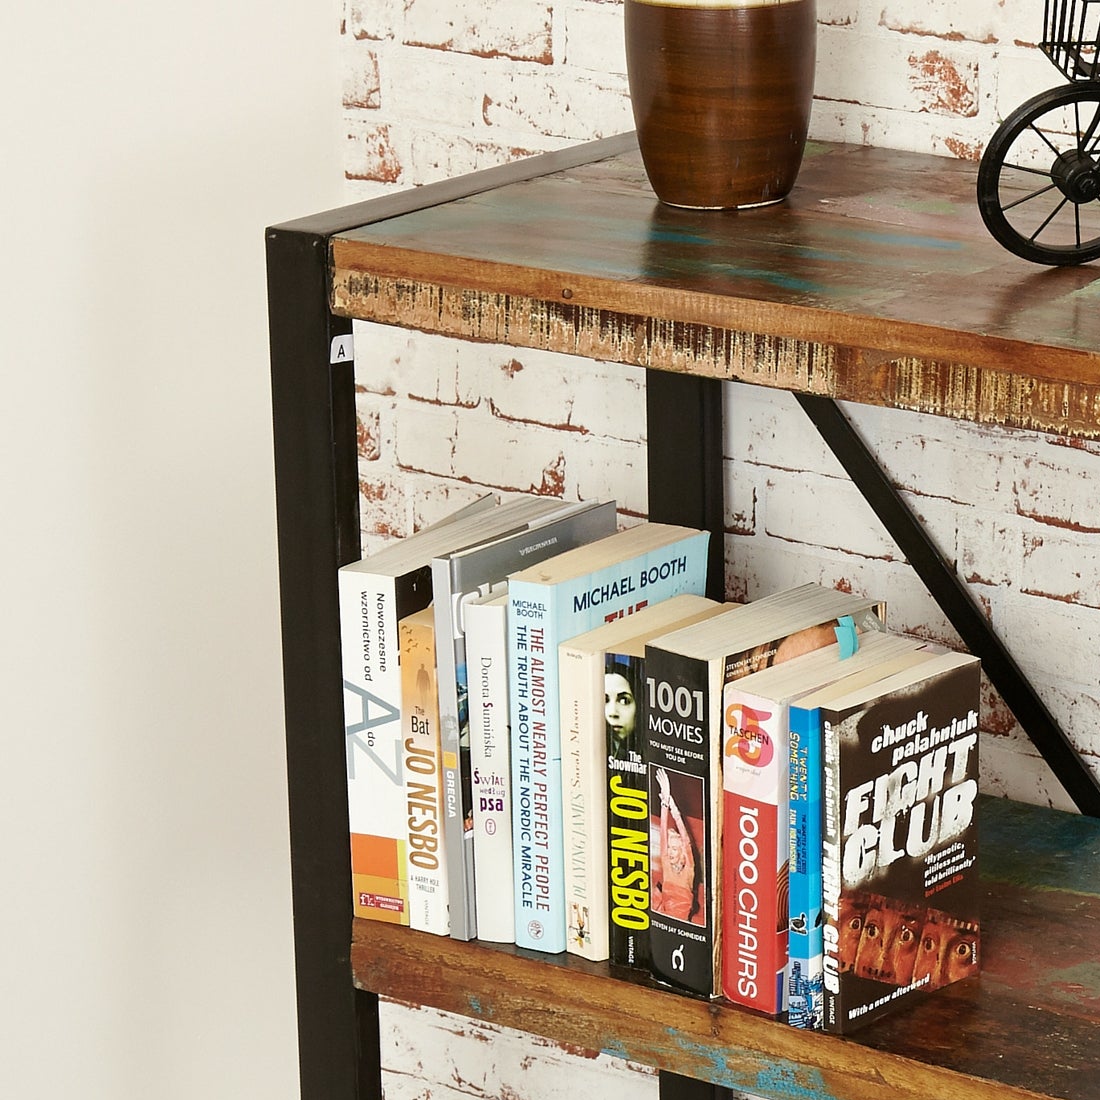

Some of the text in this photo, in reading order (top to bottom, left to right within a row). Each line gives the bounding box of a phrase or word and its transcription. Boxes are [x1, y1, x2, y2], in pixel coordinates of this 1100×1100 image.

[337, 344, 346, 358] A
[512, 599, 547, 612] MICHAEL
[573, 576, 635, 613] MICHAEL
[640, 556, 687, 588] BOOTH
[361, 591, 373, 682] wzornictwo od
[376, 593, 387, 672] Nowoczesne
[516, 609, 543, 620] BOOTH
[415, 706, 425, 716] The
[481, 657, 496, 758] Dorota Sumińska
[646, 677, 703, 722] 1001
[368, 732, 376, 747] do
[411, 715, 430, 735] Bat
[570, 699, 581, 789] Sarah Mason
[649, 714, 703, 744] MOVIES
[728, 724, 769, 745] TASCHEN
[824, 720, 835, 764] chuck
[871, 710, 929, 754] chuck
[892, 710, 979, 766] palahniuk
[517, 625, 533, 909] THE TRUTH ABOUT THE NORDIC MIRACLE
[530, 628, 550, 912] THE ALMOST NEARLY PERFECT PEOPLE
[629, 751, 642, 763] The
[649, 740, 704, 760] YOU MUST SEE BEFORE
[666, 753, 686, 764] YOU DIE
[789, 732, 800, 801] SOMETHING
[446, 771, 456, 818] GRECJA
[799, 747, 808, 801] TWENTY
[843, 733, 977, 837] FIGHT
[404, 738, 439, 871] JO NESBO
[480, 797, 503, 812] psa
[610, 775, 649, 931] JO NESBO
[842, 779, 978, 884] CLUB
[925, 850, 965, 878] pitiless and
[925, 874, 938, 887] told
[738, 805, 759, 999] 1000 CHAIRS
[822, 924, 840, 995] CLUB
[848, 973, 931, 1020] With a new afterword
